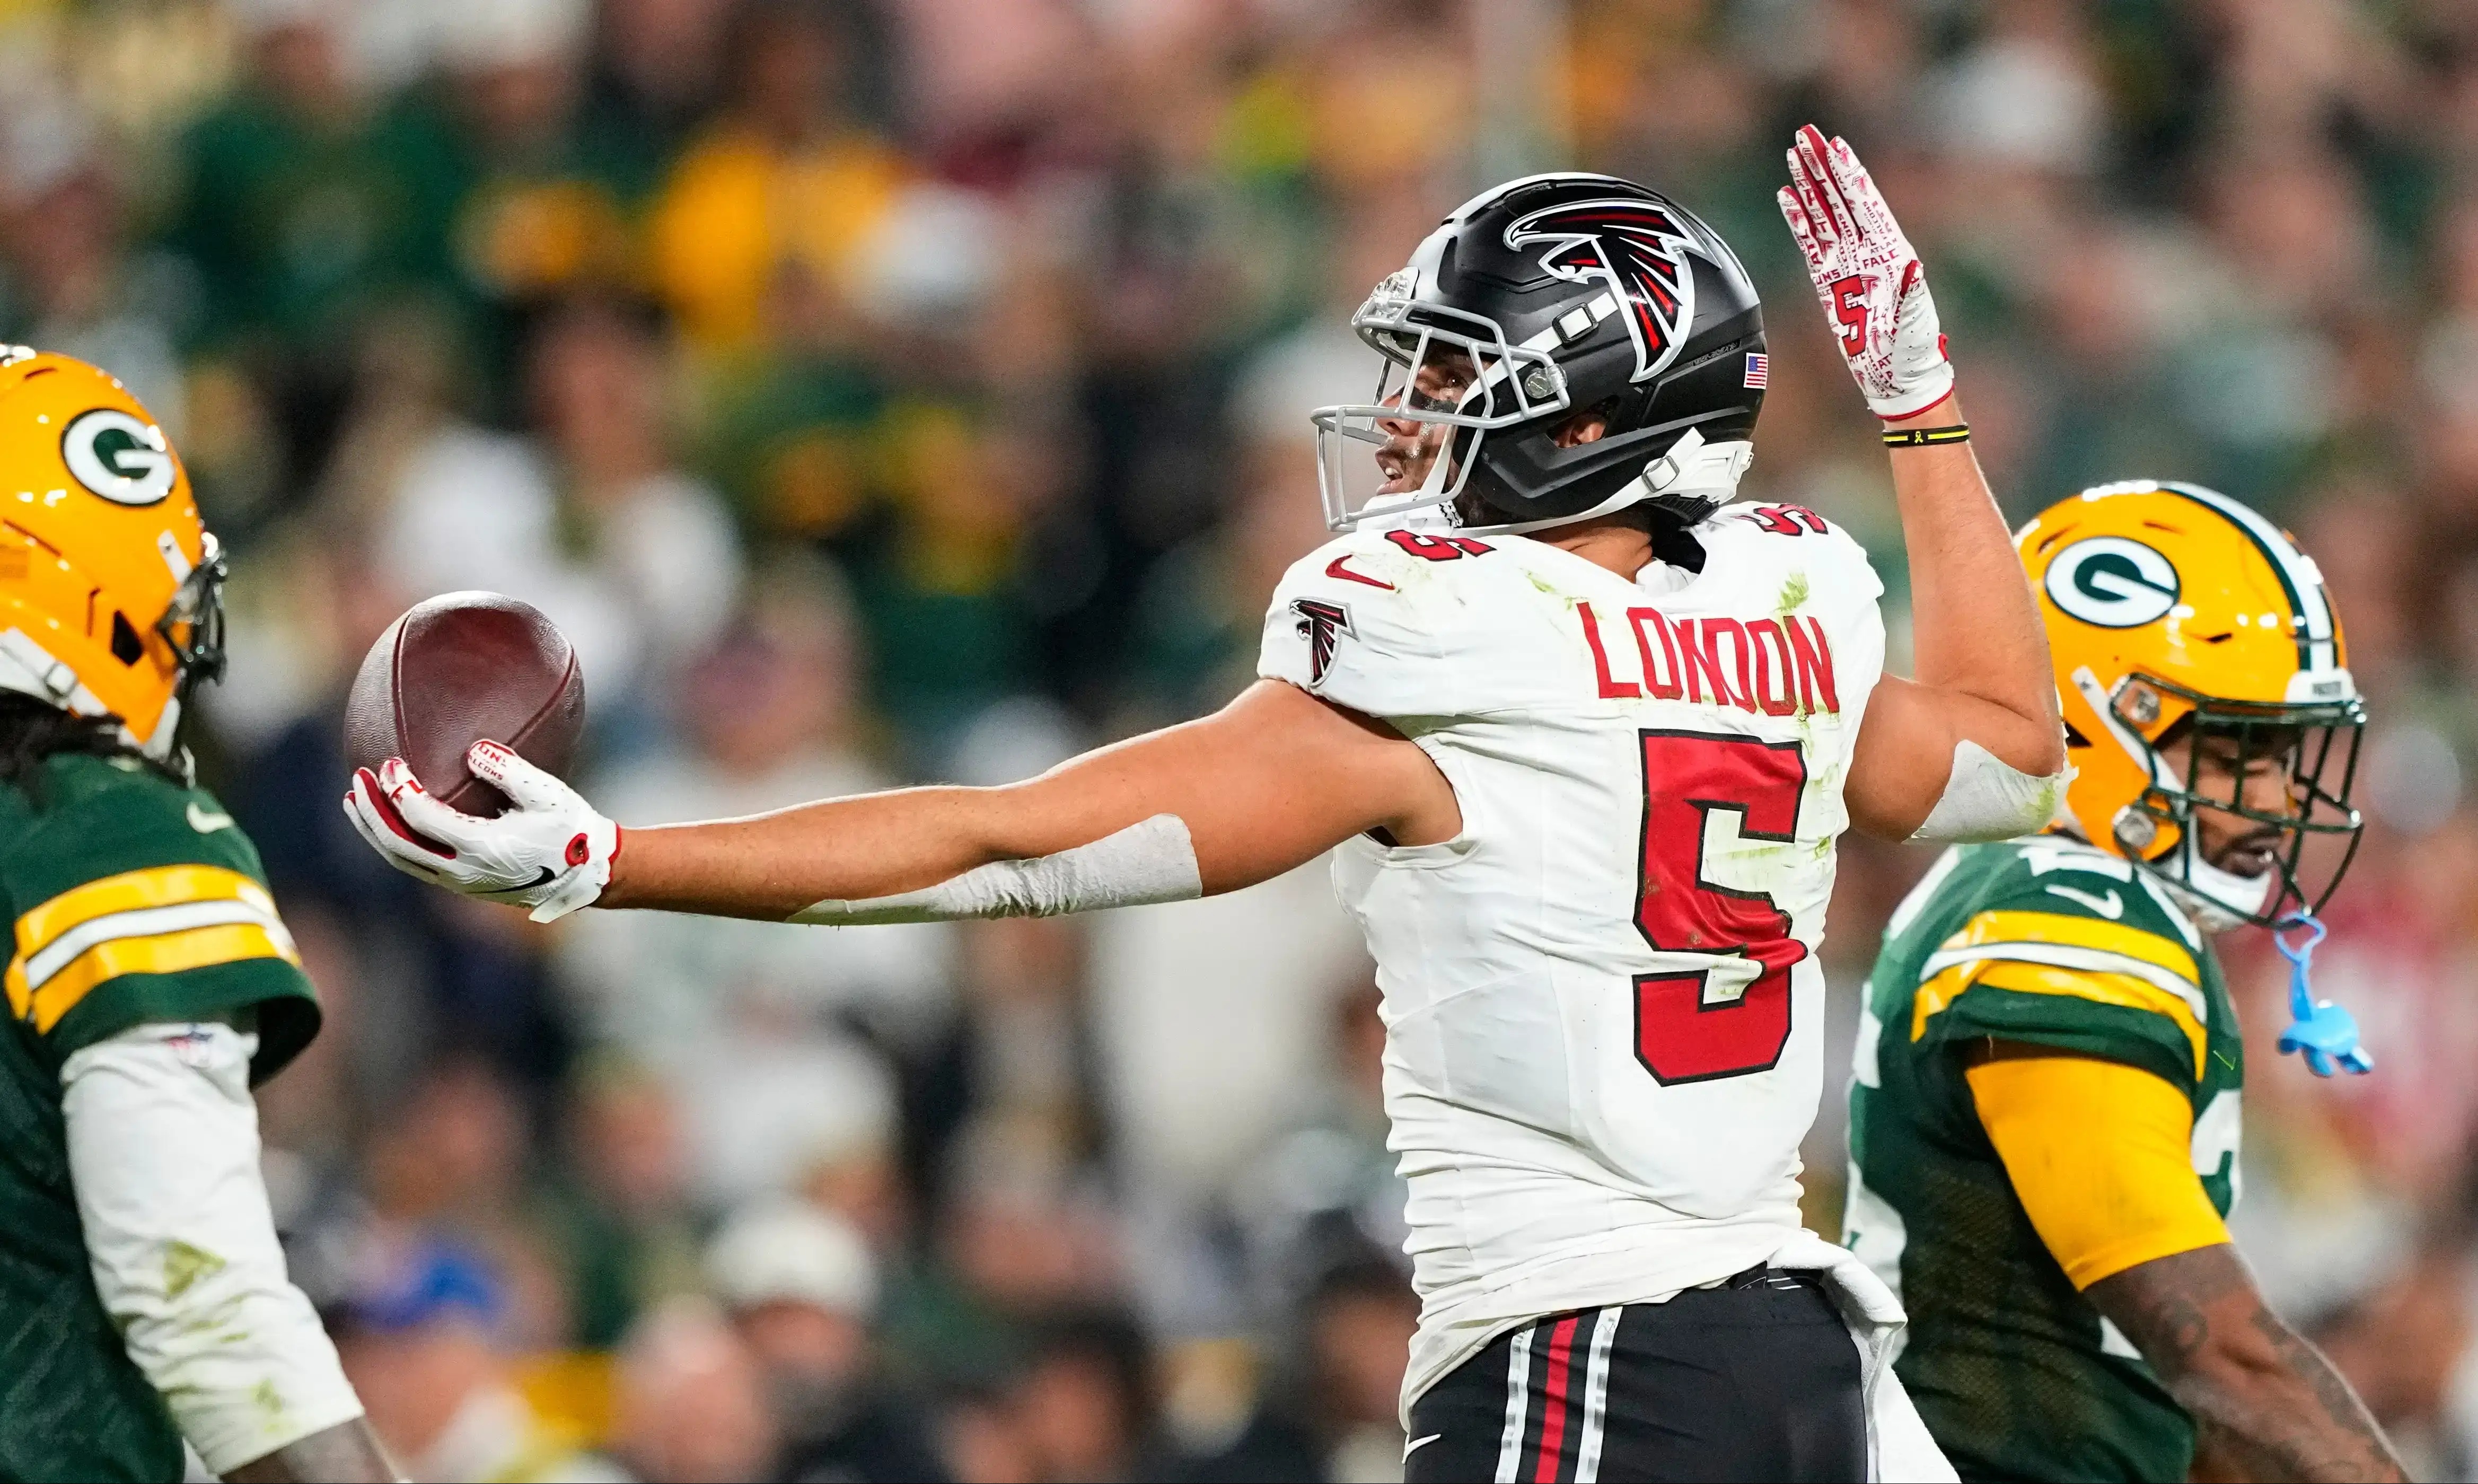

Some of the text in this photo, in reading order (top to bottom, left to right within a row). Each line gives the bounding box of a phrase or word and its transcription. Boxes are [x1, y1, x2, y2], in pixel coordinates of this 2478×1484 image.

[1830, 274, 1868, 357] 5
[60, 408, 177, 506] G
[1384, 529, 1497, 562] 5
[1733, 503, 1829, 537] 5
[2044, 535, 2181, 628] G
[1576, 601, 1840, 716] LONDON
[1632, 727, 1808, 1087] 5
